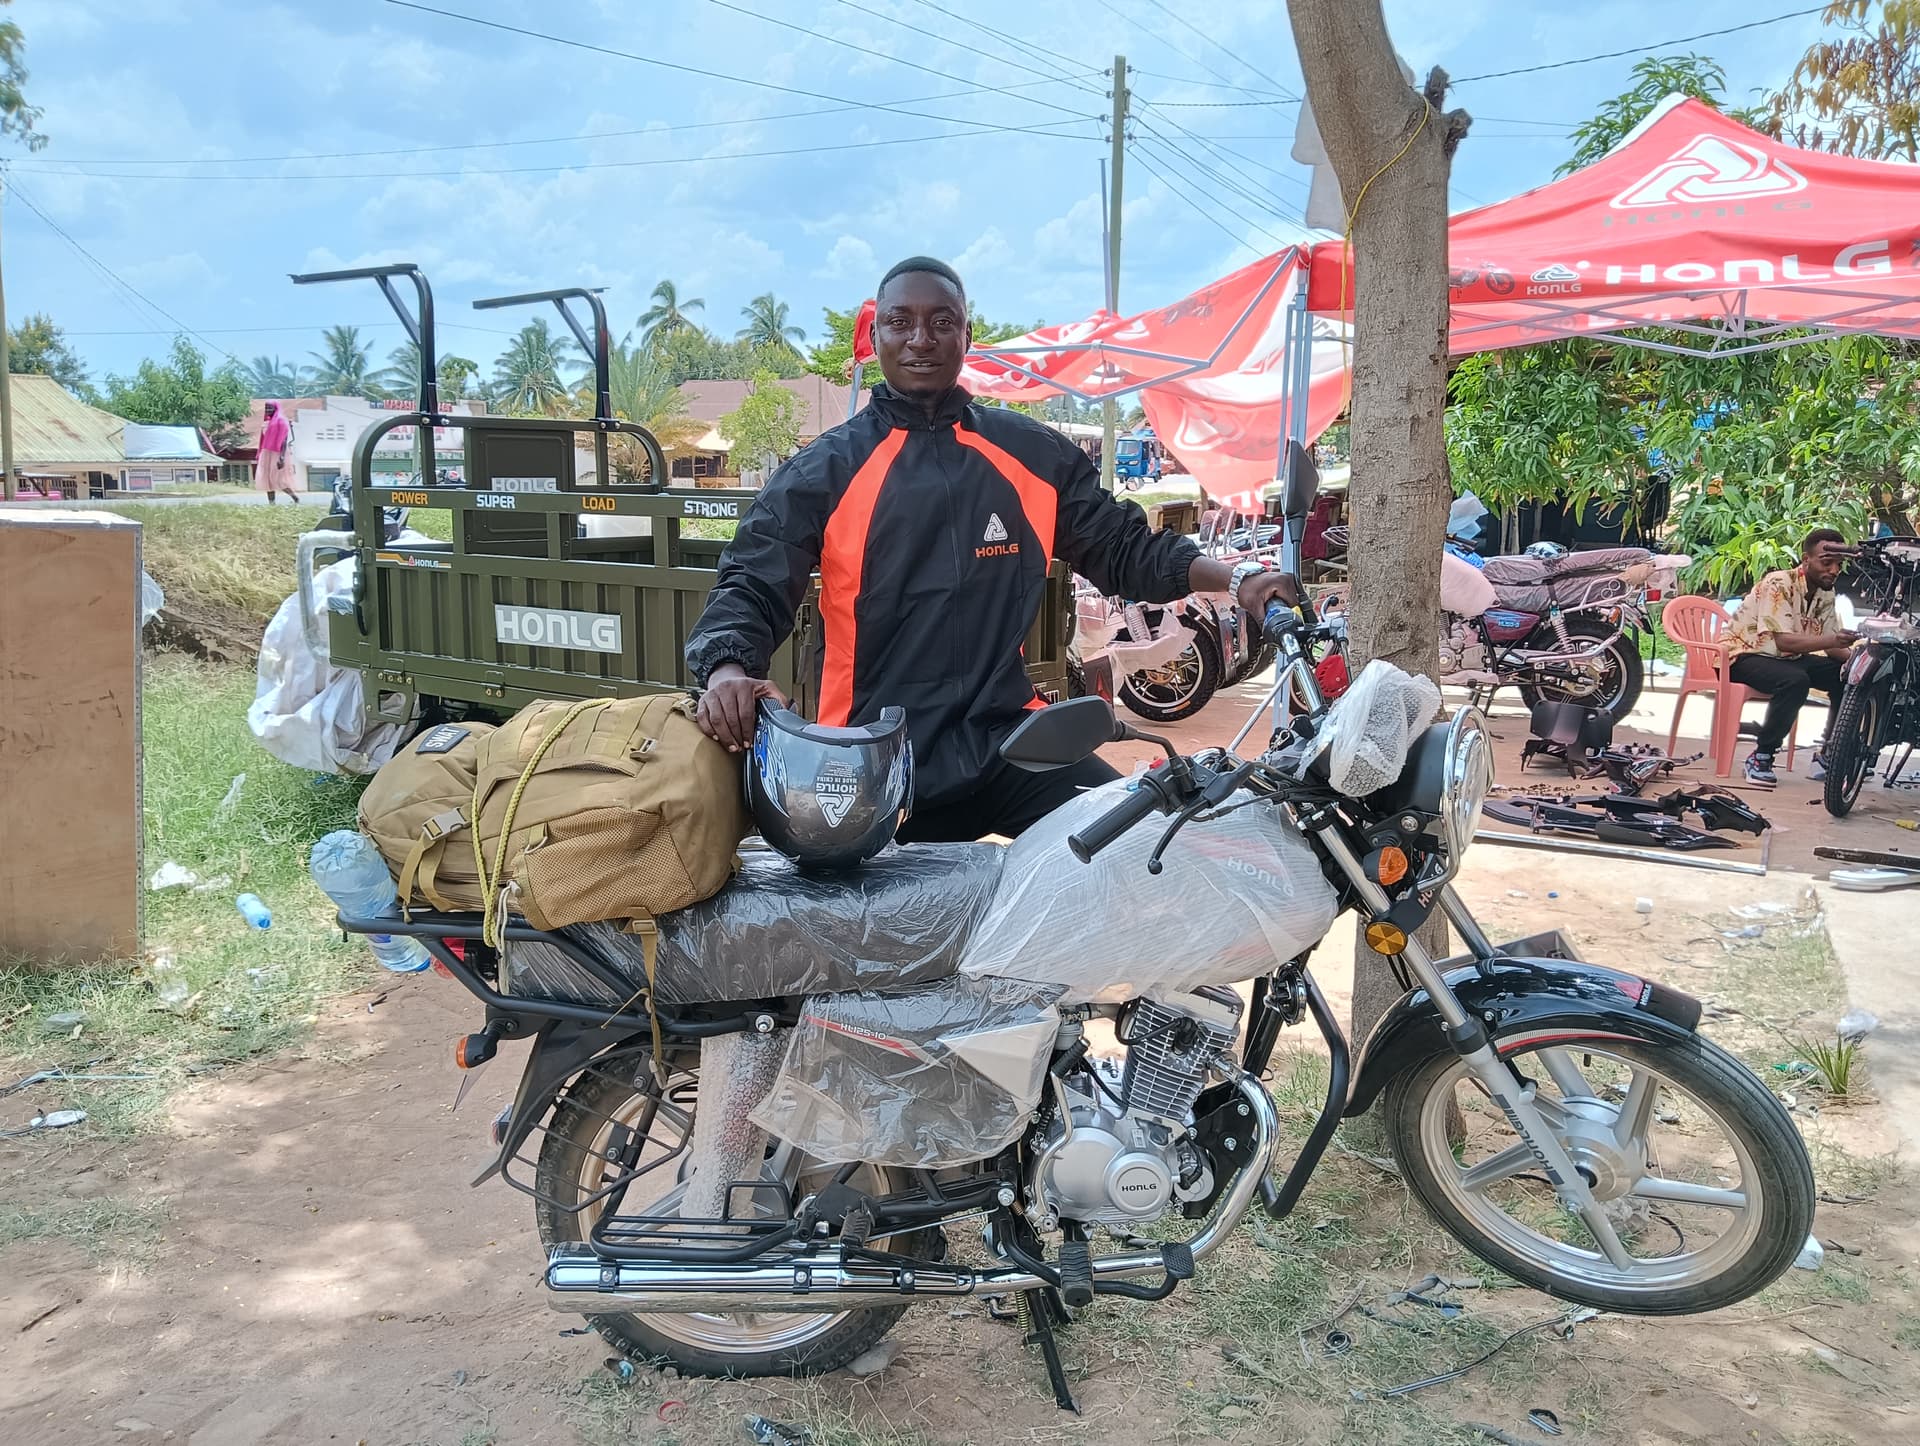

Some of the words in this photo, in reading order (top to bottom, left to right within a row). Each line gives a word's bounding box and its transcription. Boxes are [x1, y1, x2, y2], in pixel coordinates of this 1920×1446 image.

[1605, 239, 1893, 284] HONLG
[1526, 283, 1582, 295] HONLG
[493, 479, 556, 492] HONLG
[391, 491, 428, 504] POWER
[476, 494, 516, 509] SUPER
[582, 496, 616, 511] LOAD
[684, 500, 738, 517] STRONG
[975, 543, 1019, 558] HONLG
[496, 609, 616, 649] HONLG
[425, 727, 460, 748] SWAT
[816, 783, 857, 794] HONLG
[1227, 856, 1295, 897] HONLG
[1121, 1183, 1157, 1192] HONLG
